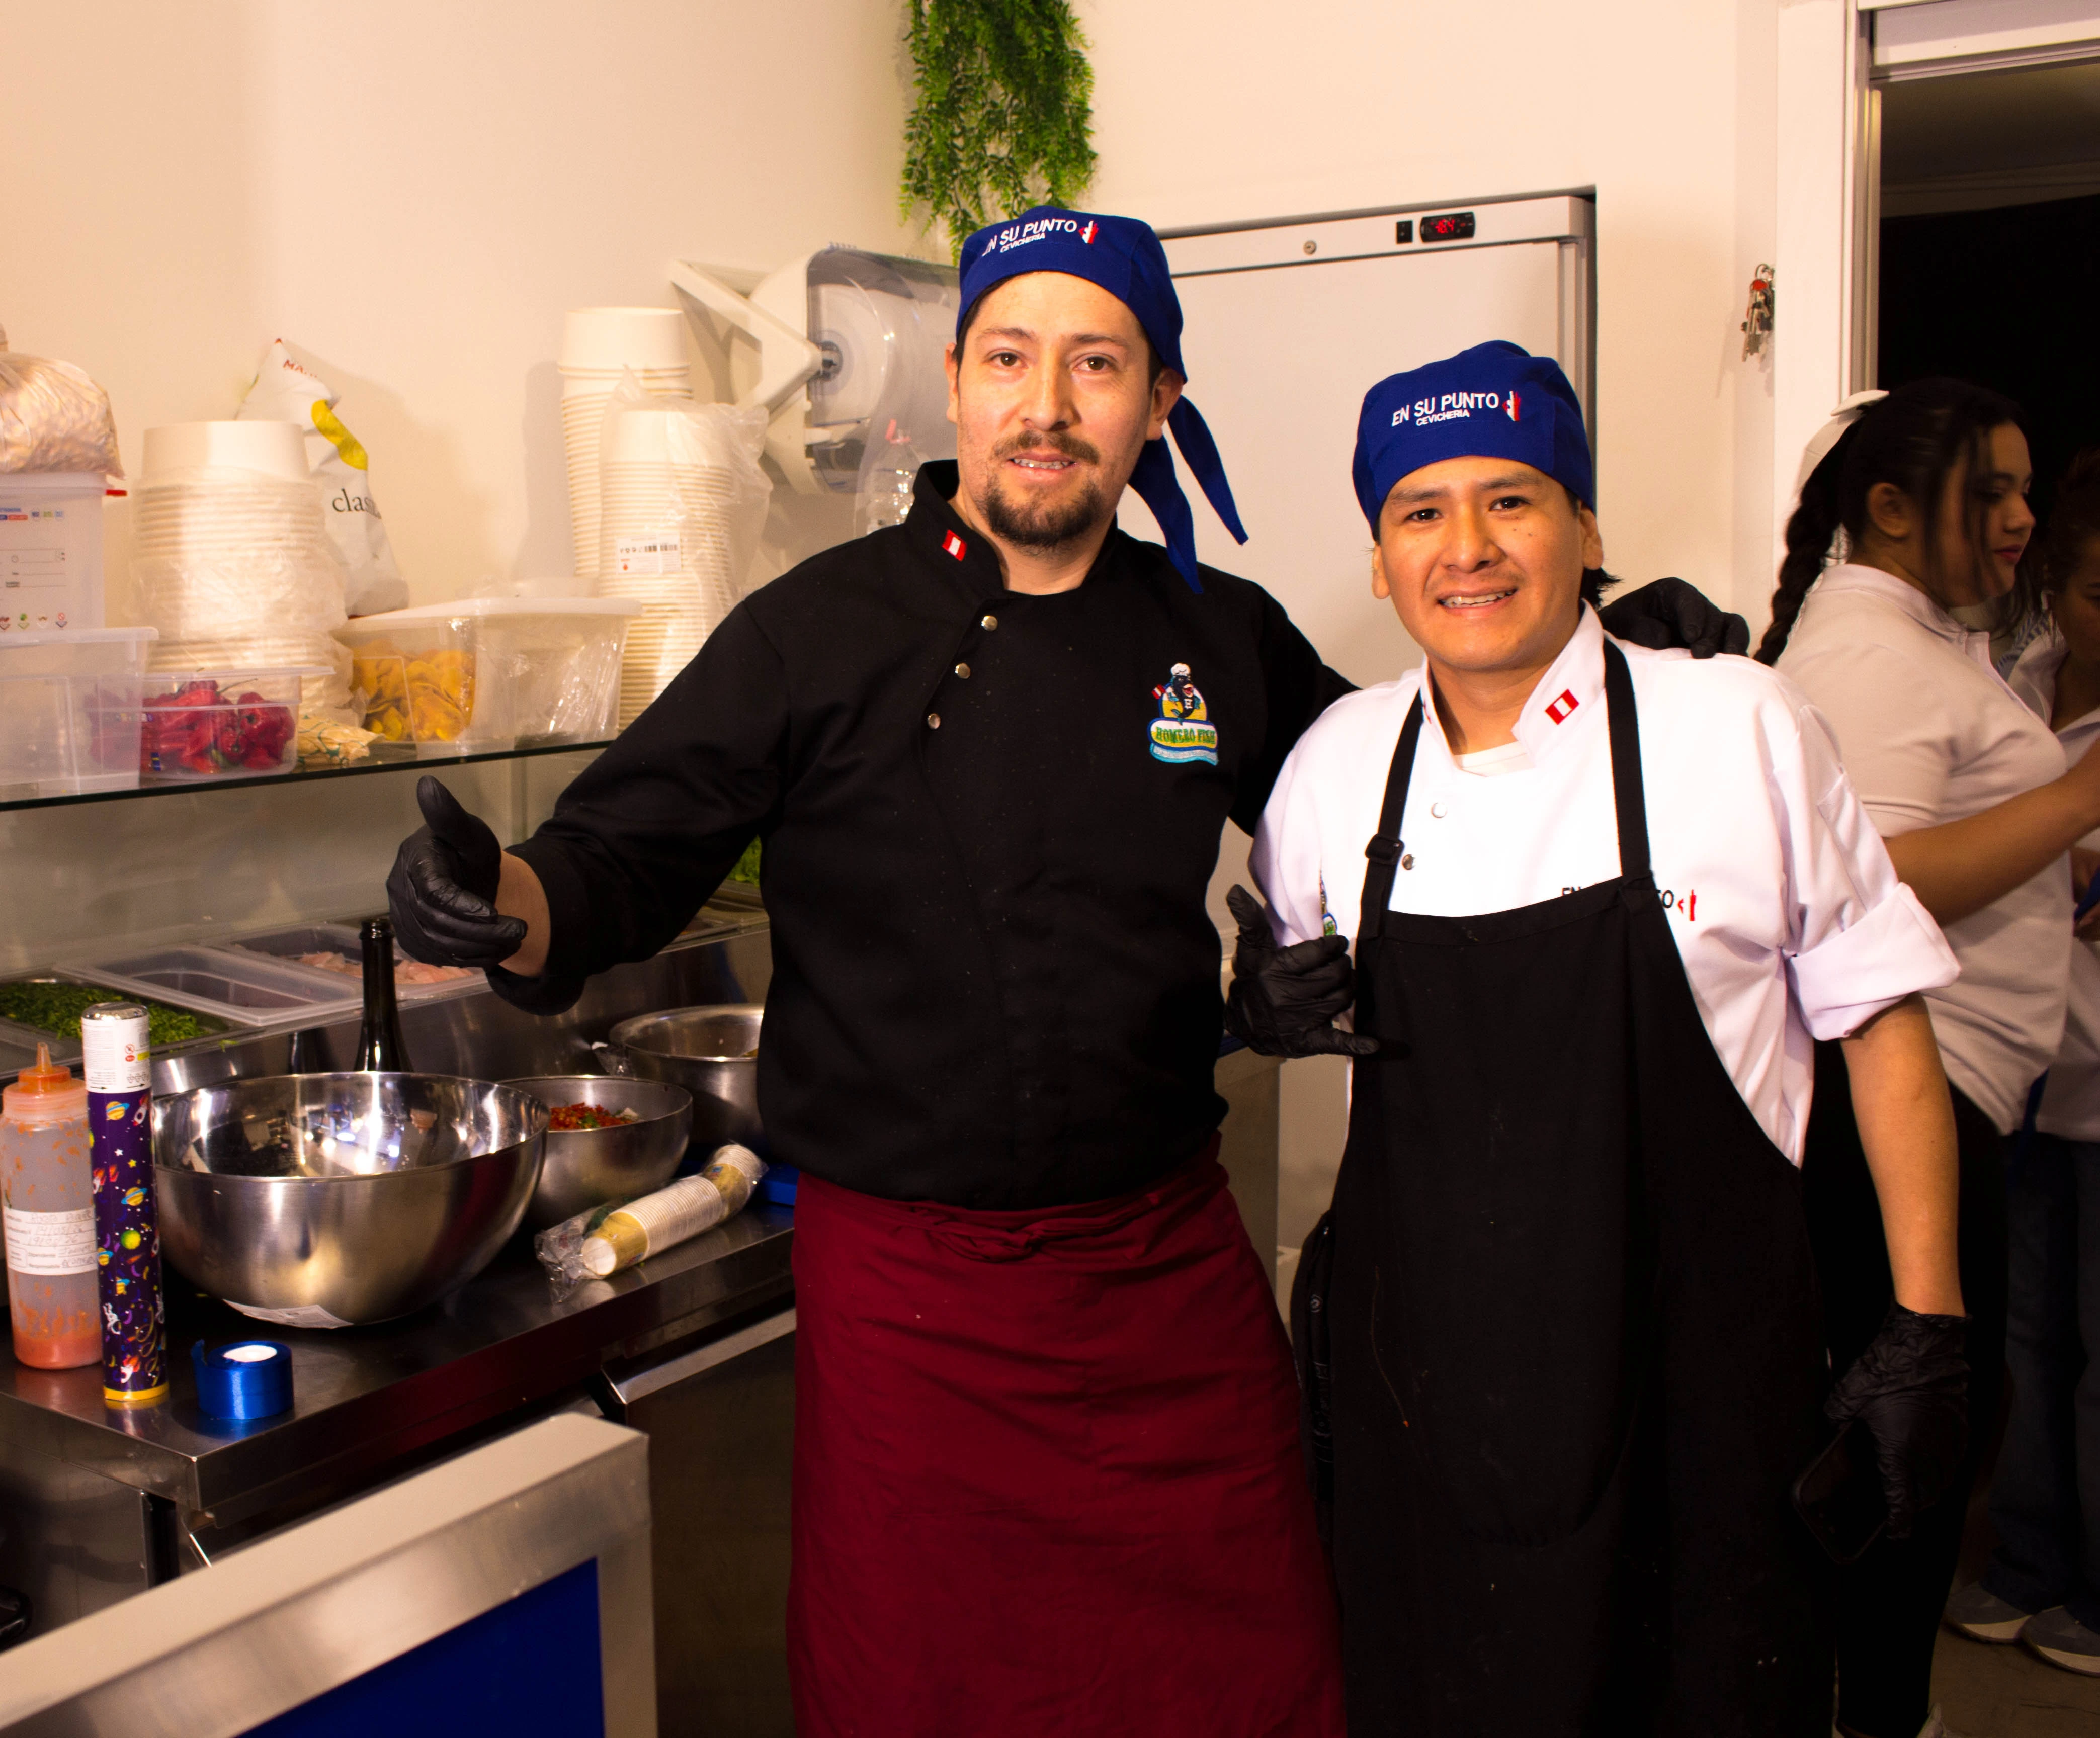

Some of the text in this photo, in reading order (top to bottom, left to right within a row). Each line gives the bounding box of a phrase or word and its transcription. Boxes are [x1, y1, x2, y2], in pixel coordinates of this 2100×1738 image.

[999, 225, 1020, 246] SU
[1022, 218, 1078, 238] PUNTO
[1000, 232, 1046, 253] CEVICHERIA
[1392, 392, 1499, 426] EN SU PUNTO
[1415, 409, 1470, 426] CEVICHERIA
